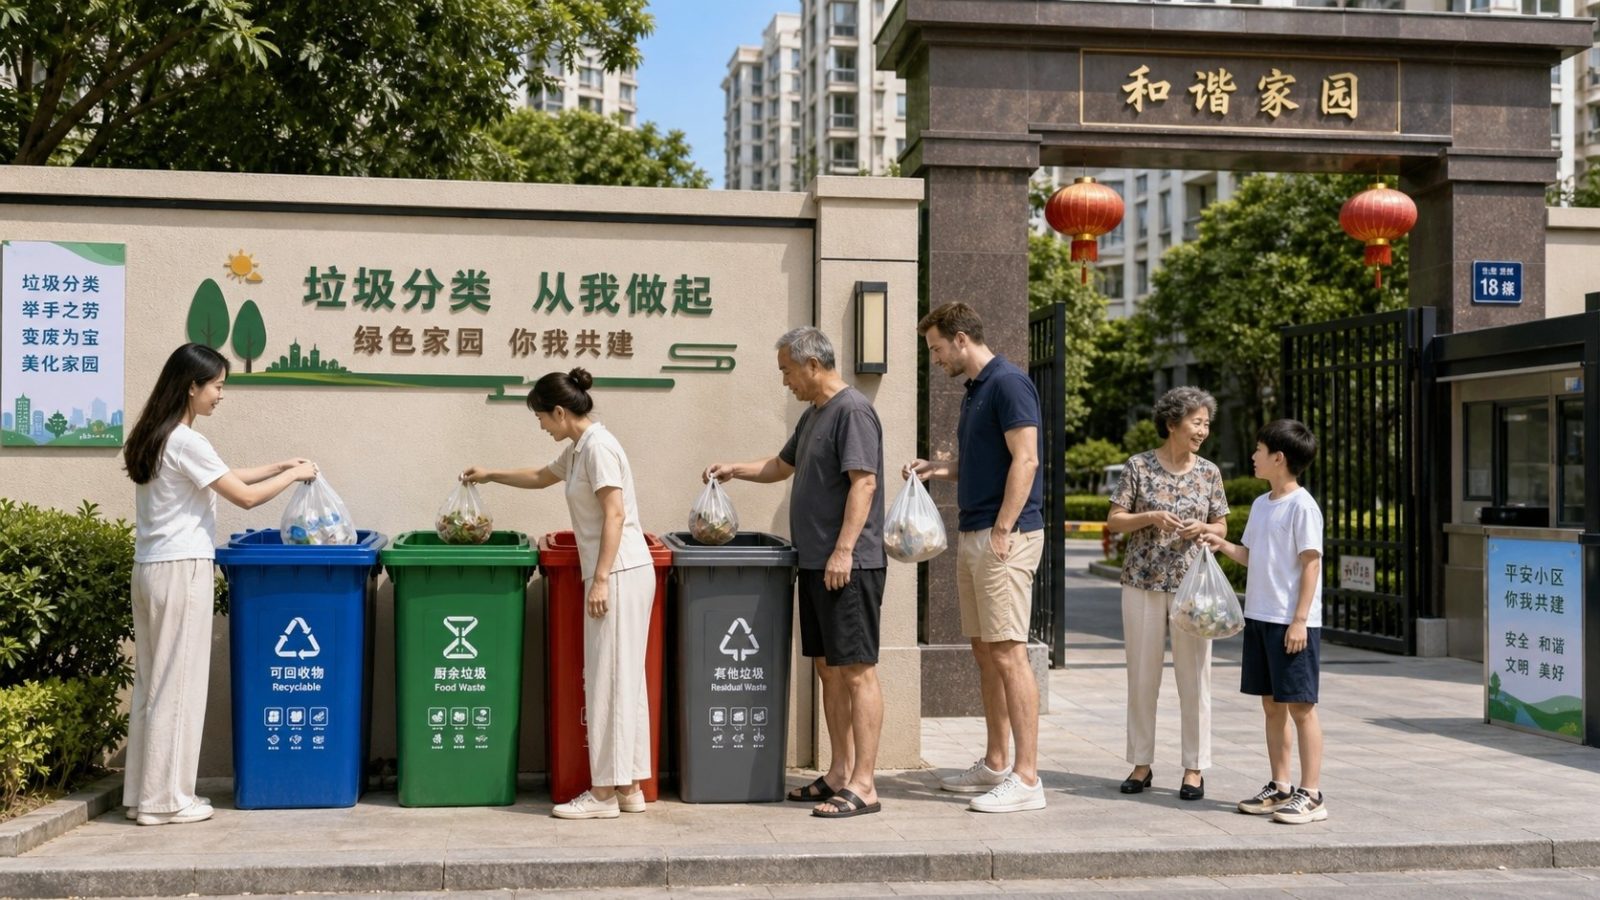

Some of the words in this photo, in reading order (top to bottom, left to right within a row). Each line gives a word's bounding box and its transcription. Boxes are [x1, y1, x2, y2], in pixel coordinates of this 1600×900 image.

[1121, 64, 1359, 120] 和谐家园
[21, 274, 100, 293] 垃圾分类
[303, 265, 492, 313] 垃圾分类
[532, 271, 714, 317] 从我做起
[1480, 277, 1499, 296] 18
[21, 301, 100, 320] 举手之劳
[21, 328, 100, 346] 变废为宝
[353, 324, 485, 356] 绿色家园
[509, 328, 635, 358] 你我共建
[21, 355, 100, 373] 美化家园
[1504, 563, 1565, 587] 平安小区
[1504, 590, 1565, 615] 你我共建
[1505, 631, 1529, 650] 安全
[1538, 635, 1565, 655] 和谐
[270, 666, 324, 680] 可回收物
[434, 666, 486, 680] 厨余垃圾
[1505, 656, 1529, 676] 文明
[1538, 661, 1565, 682] 美好
[272, 682, 321, 693] Recyclable
[434, 683, 457, 692] Food
[459, 683, 486, 692] Waste
[711, 683, 743, 692] Residual
[744, 683, 768, 692] Waste
